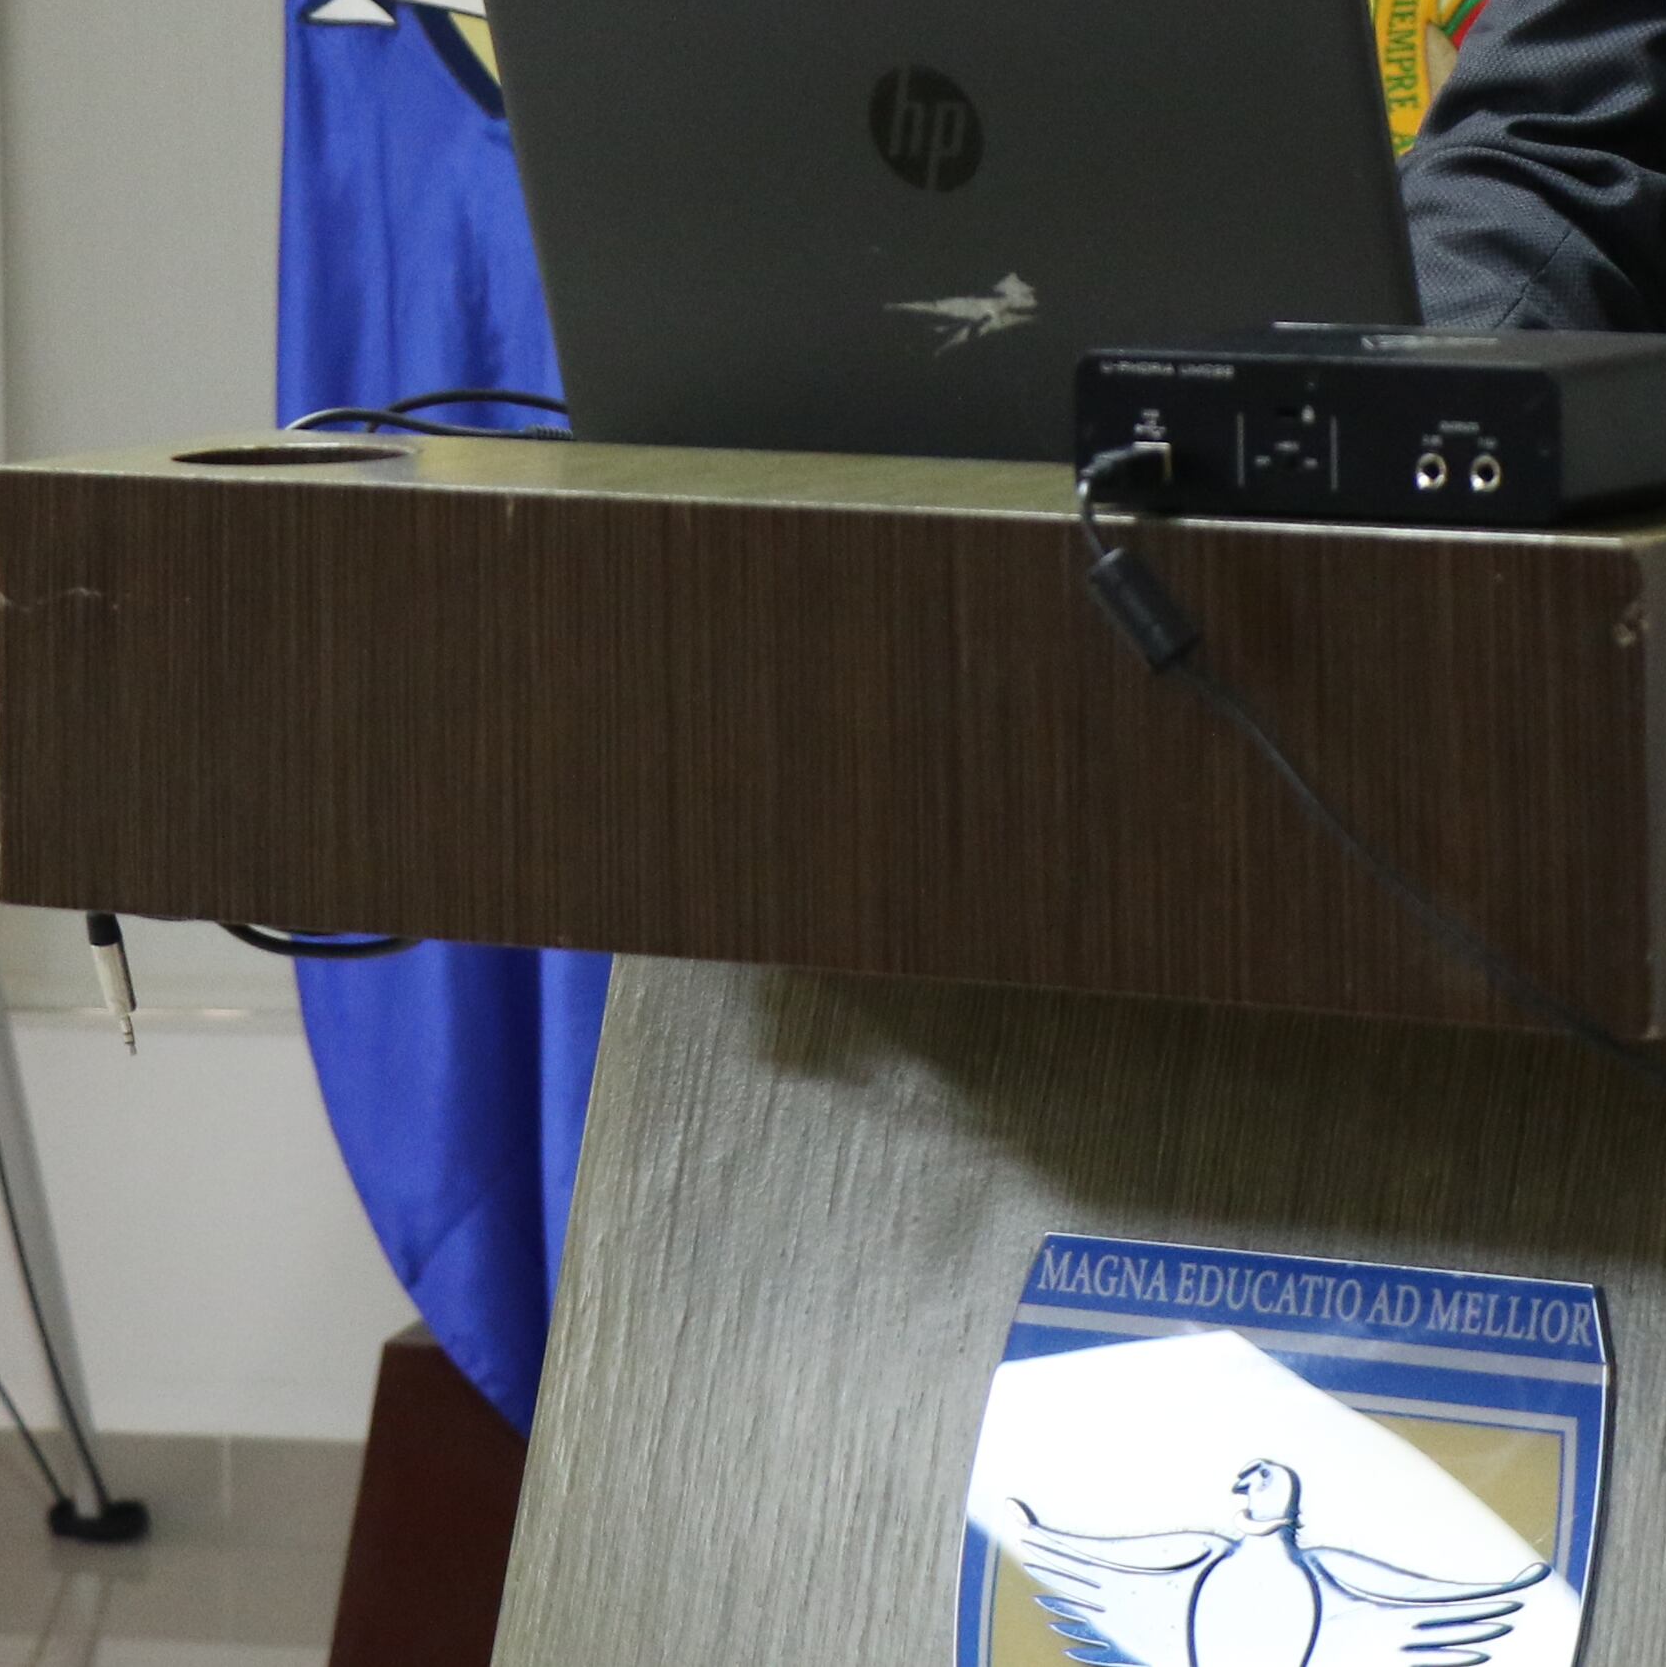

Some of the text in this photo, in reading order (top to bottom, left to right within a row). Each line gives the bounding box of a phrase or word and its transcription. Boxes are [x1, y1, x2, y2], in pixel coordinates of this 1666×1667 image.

[889, 66, 969, 190] hp
[1037, 1249, 1594, 1348] MAGNA EDUCATIO AD MELLIOR
